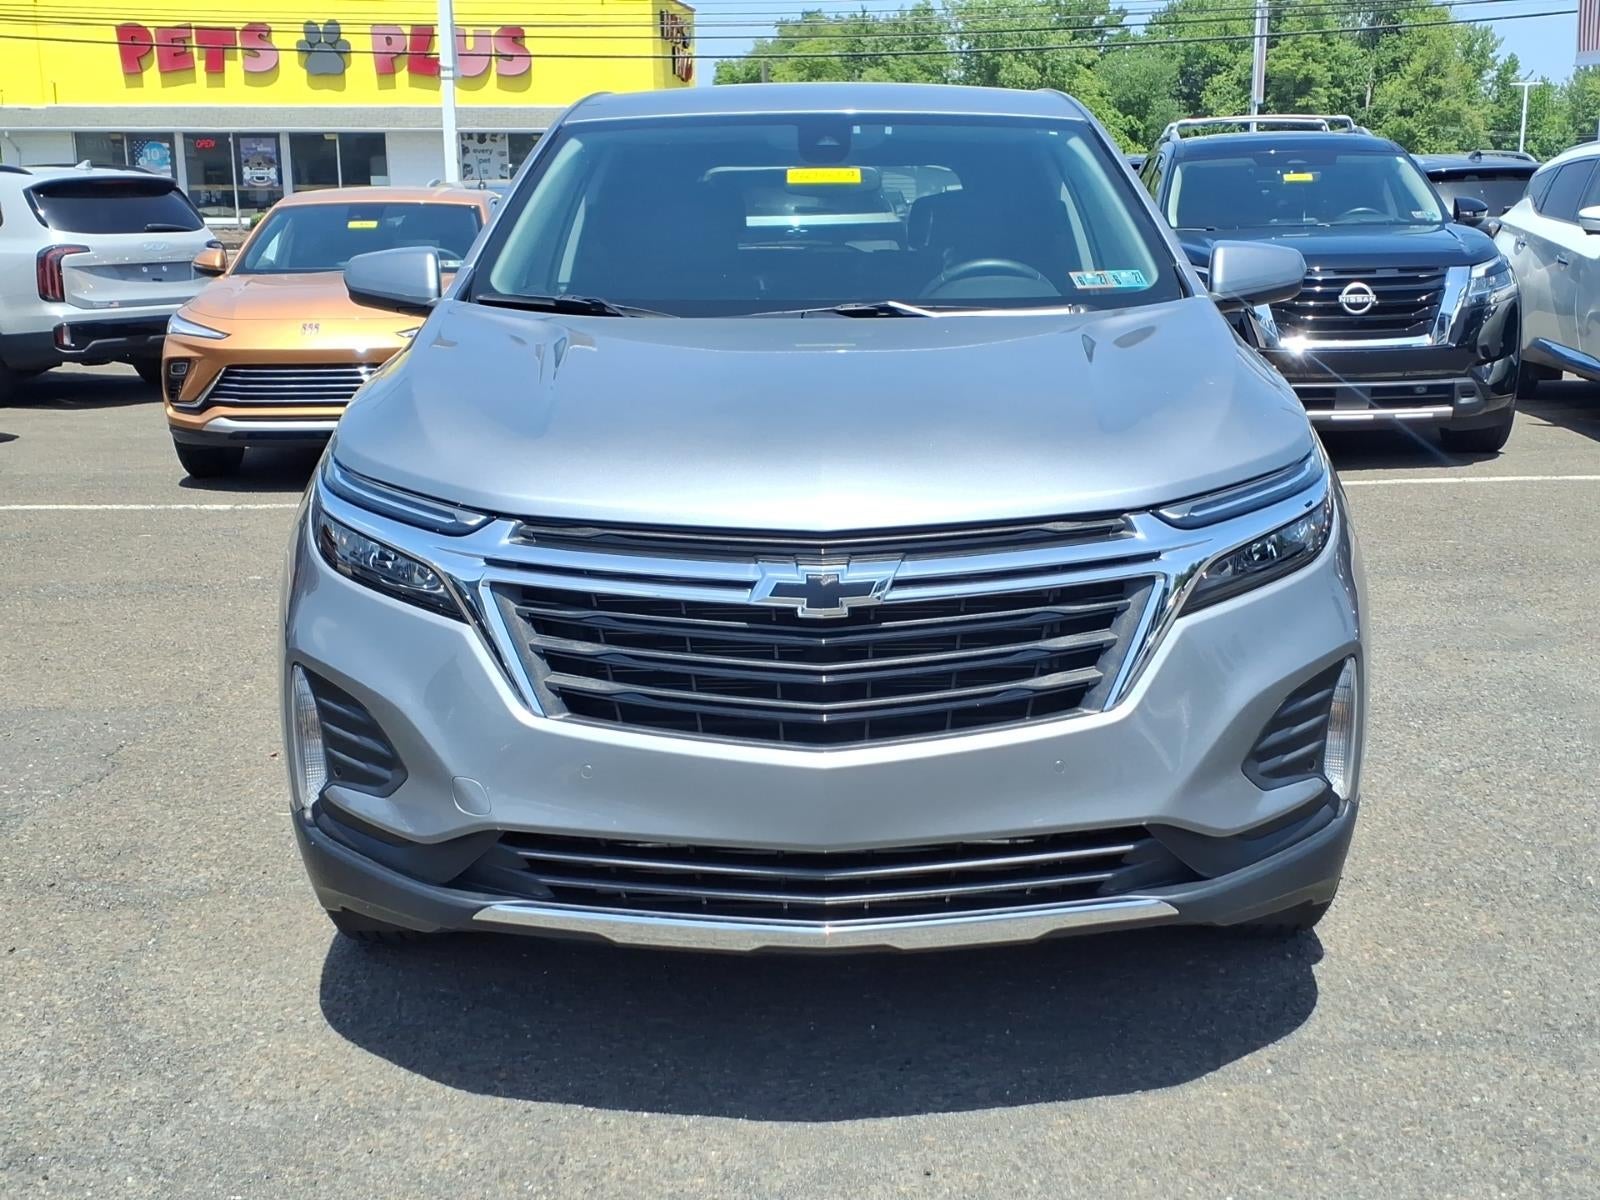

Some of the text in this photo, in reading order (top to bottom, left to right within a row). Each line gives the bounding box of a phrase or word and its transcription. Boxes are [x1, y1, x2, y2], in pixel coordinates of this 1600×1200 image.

[115, 22, 532, 78] PETS PLUS
[195, 138, 215, 148] OPEN
[472, 148, 493, 156] every
[1338, 294, 1376, 303] NISSAN
